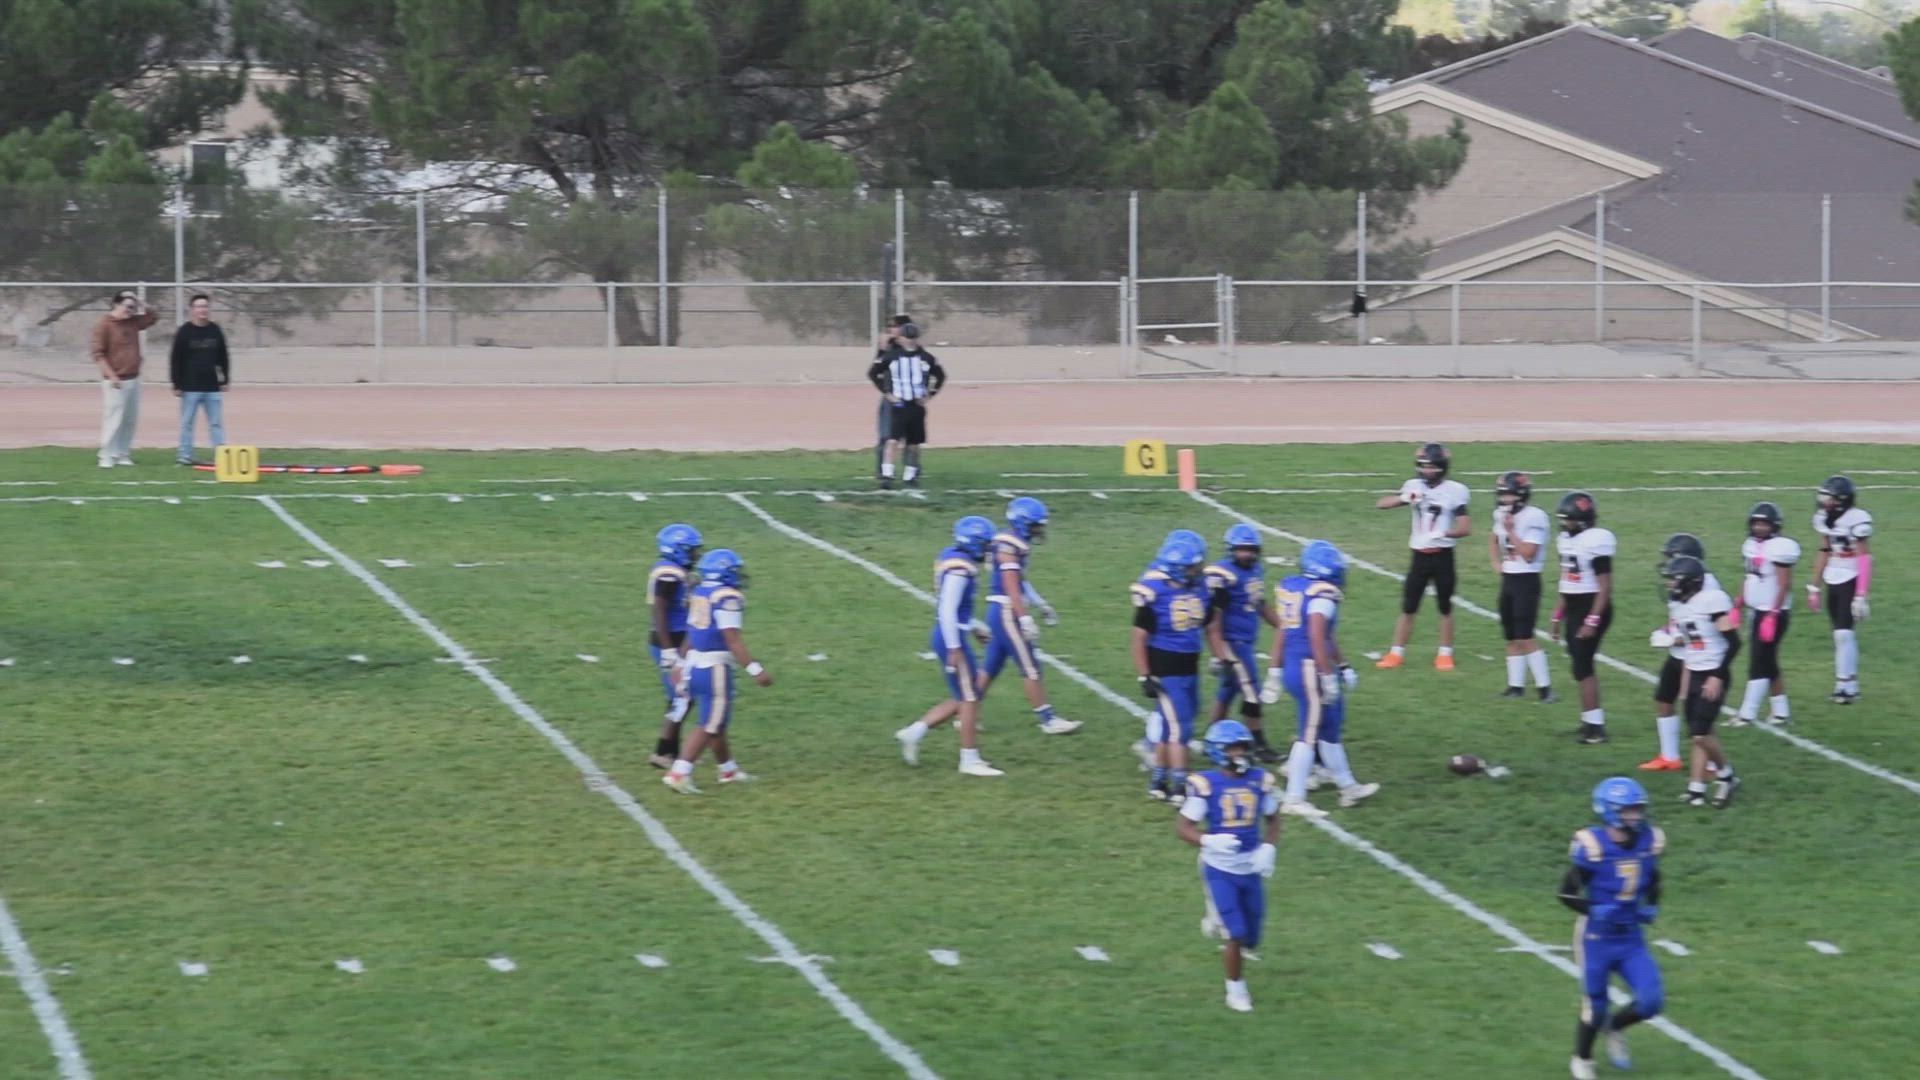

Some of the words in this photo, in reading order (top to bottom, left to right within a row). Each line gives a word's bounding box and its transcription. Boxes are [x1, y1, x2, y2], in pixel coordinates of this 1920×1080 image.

[224, 447, 249, 476] 10
[1138, 443, 1155, 470] G
[1615, 863, 1641, 901] 7
